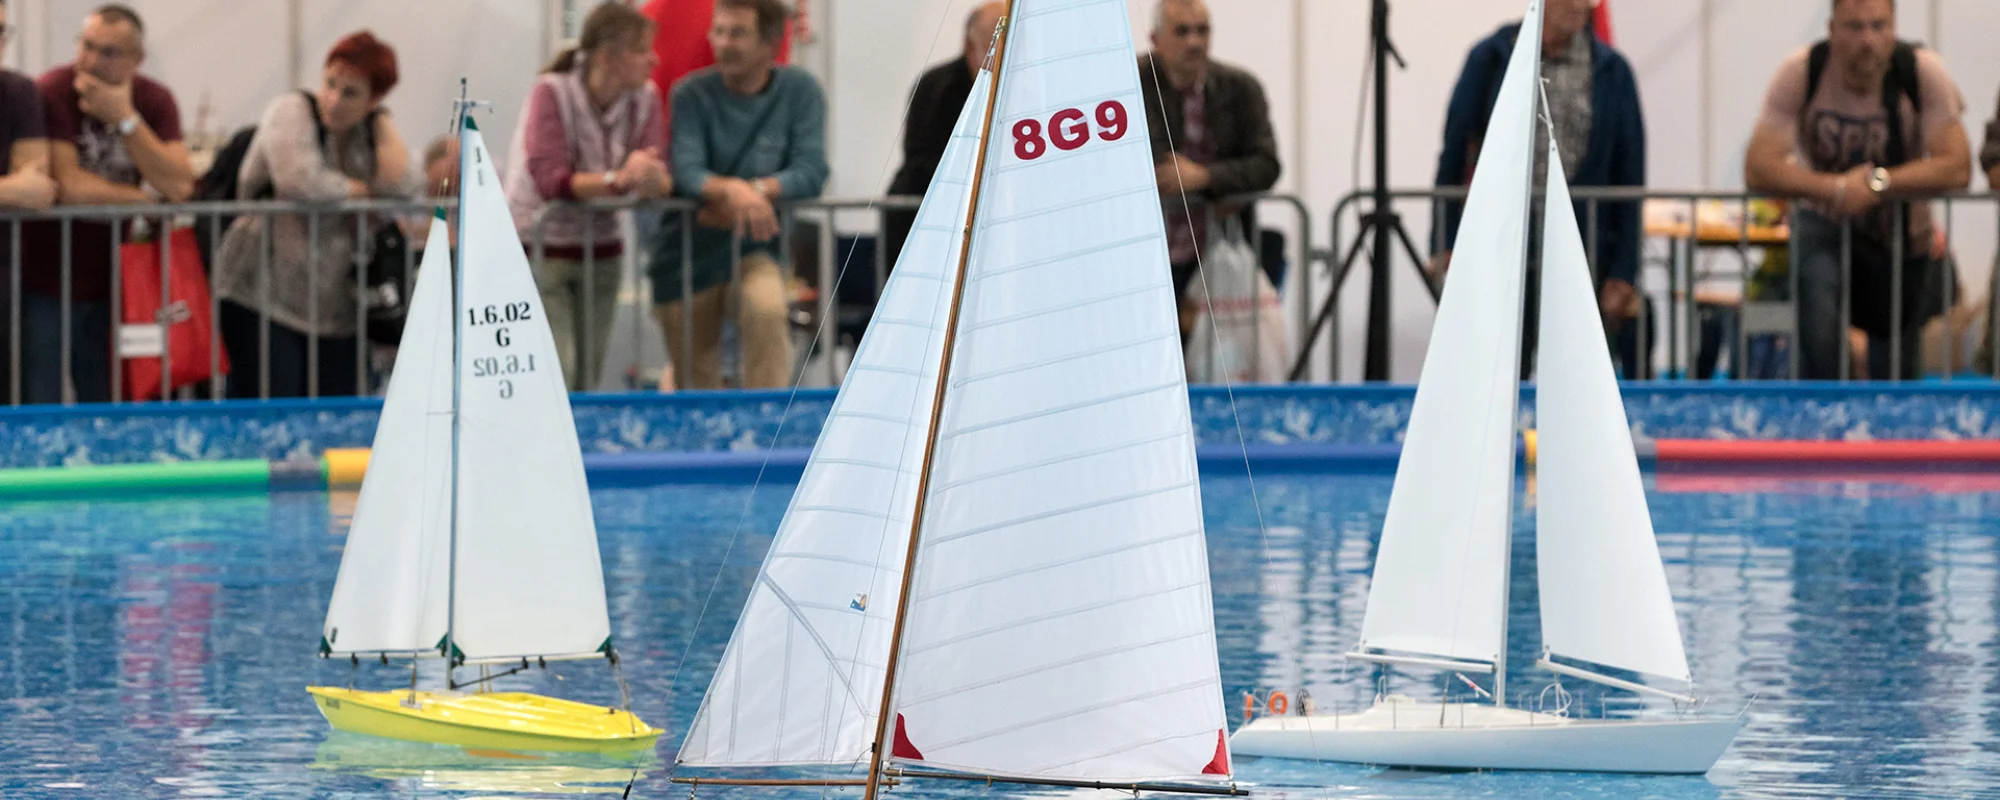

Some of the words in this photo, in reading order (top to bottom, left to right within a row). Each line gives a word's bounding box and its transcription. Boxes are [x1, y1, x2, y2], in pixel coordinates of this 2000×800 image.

[1012, 100, 1128, 160] 8G9
[468, 301, 532, 326] 1.6.02
[496, 327, 510, 347] G
